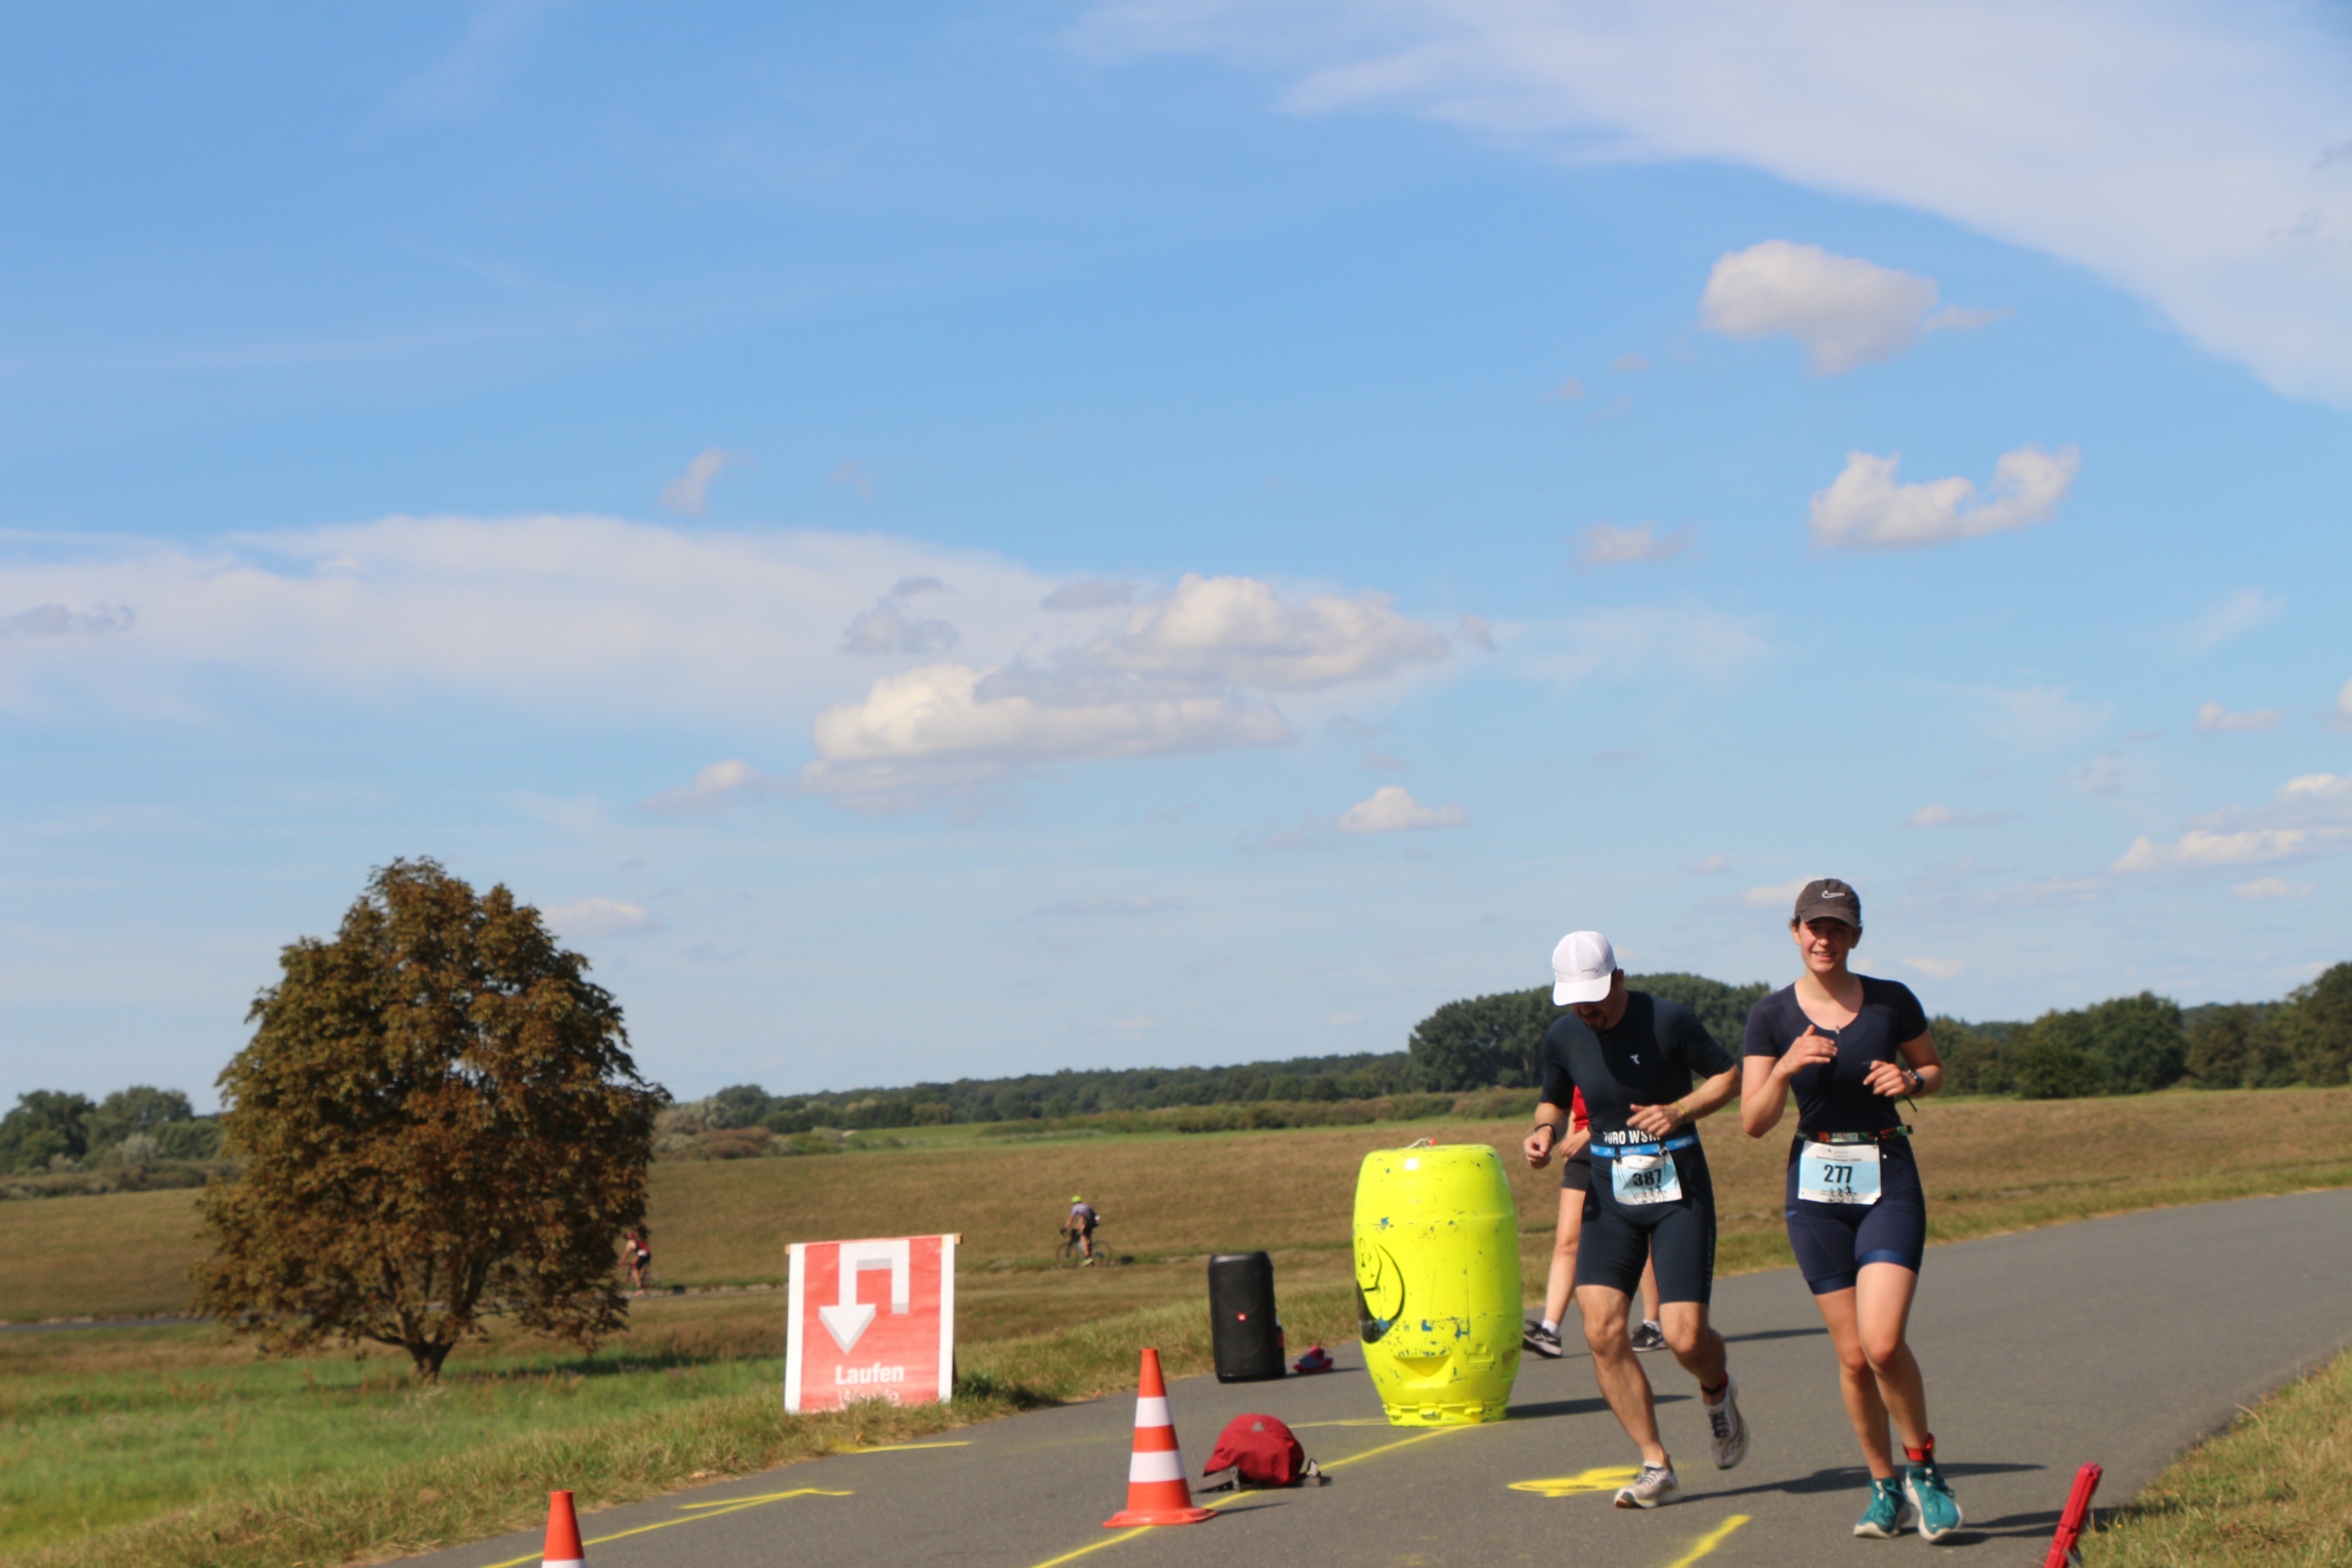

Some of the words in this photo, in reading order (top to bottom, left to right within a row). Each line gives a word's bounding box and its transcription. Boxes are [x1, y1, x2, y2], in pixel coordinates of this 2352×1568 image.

[1632, 1168, 1661, 1186] 387
[1823, 1164, 1853, 1183] 277
[835, 1362, 904, 1386] Laufen
